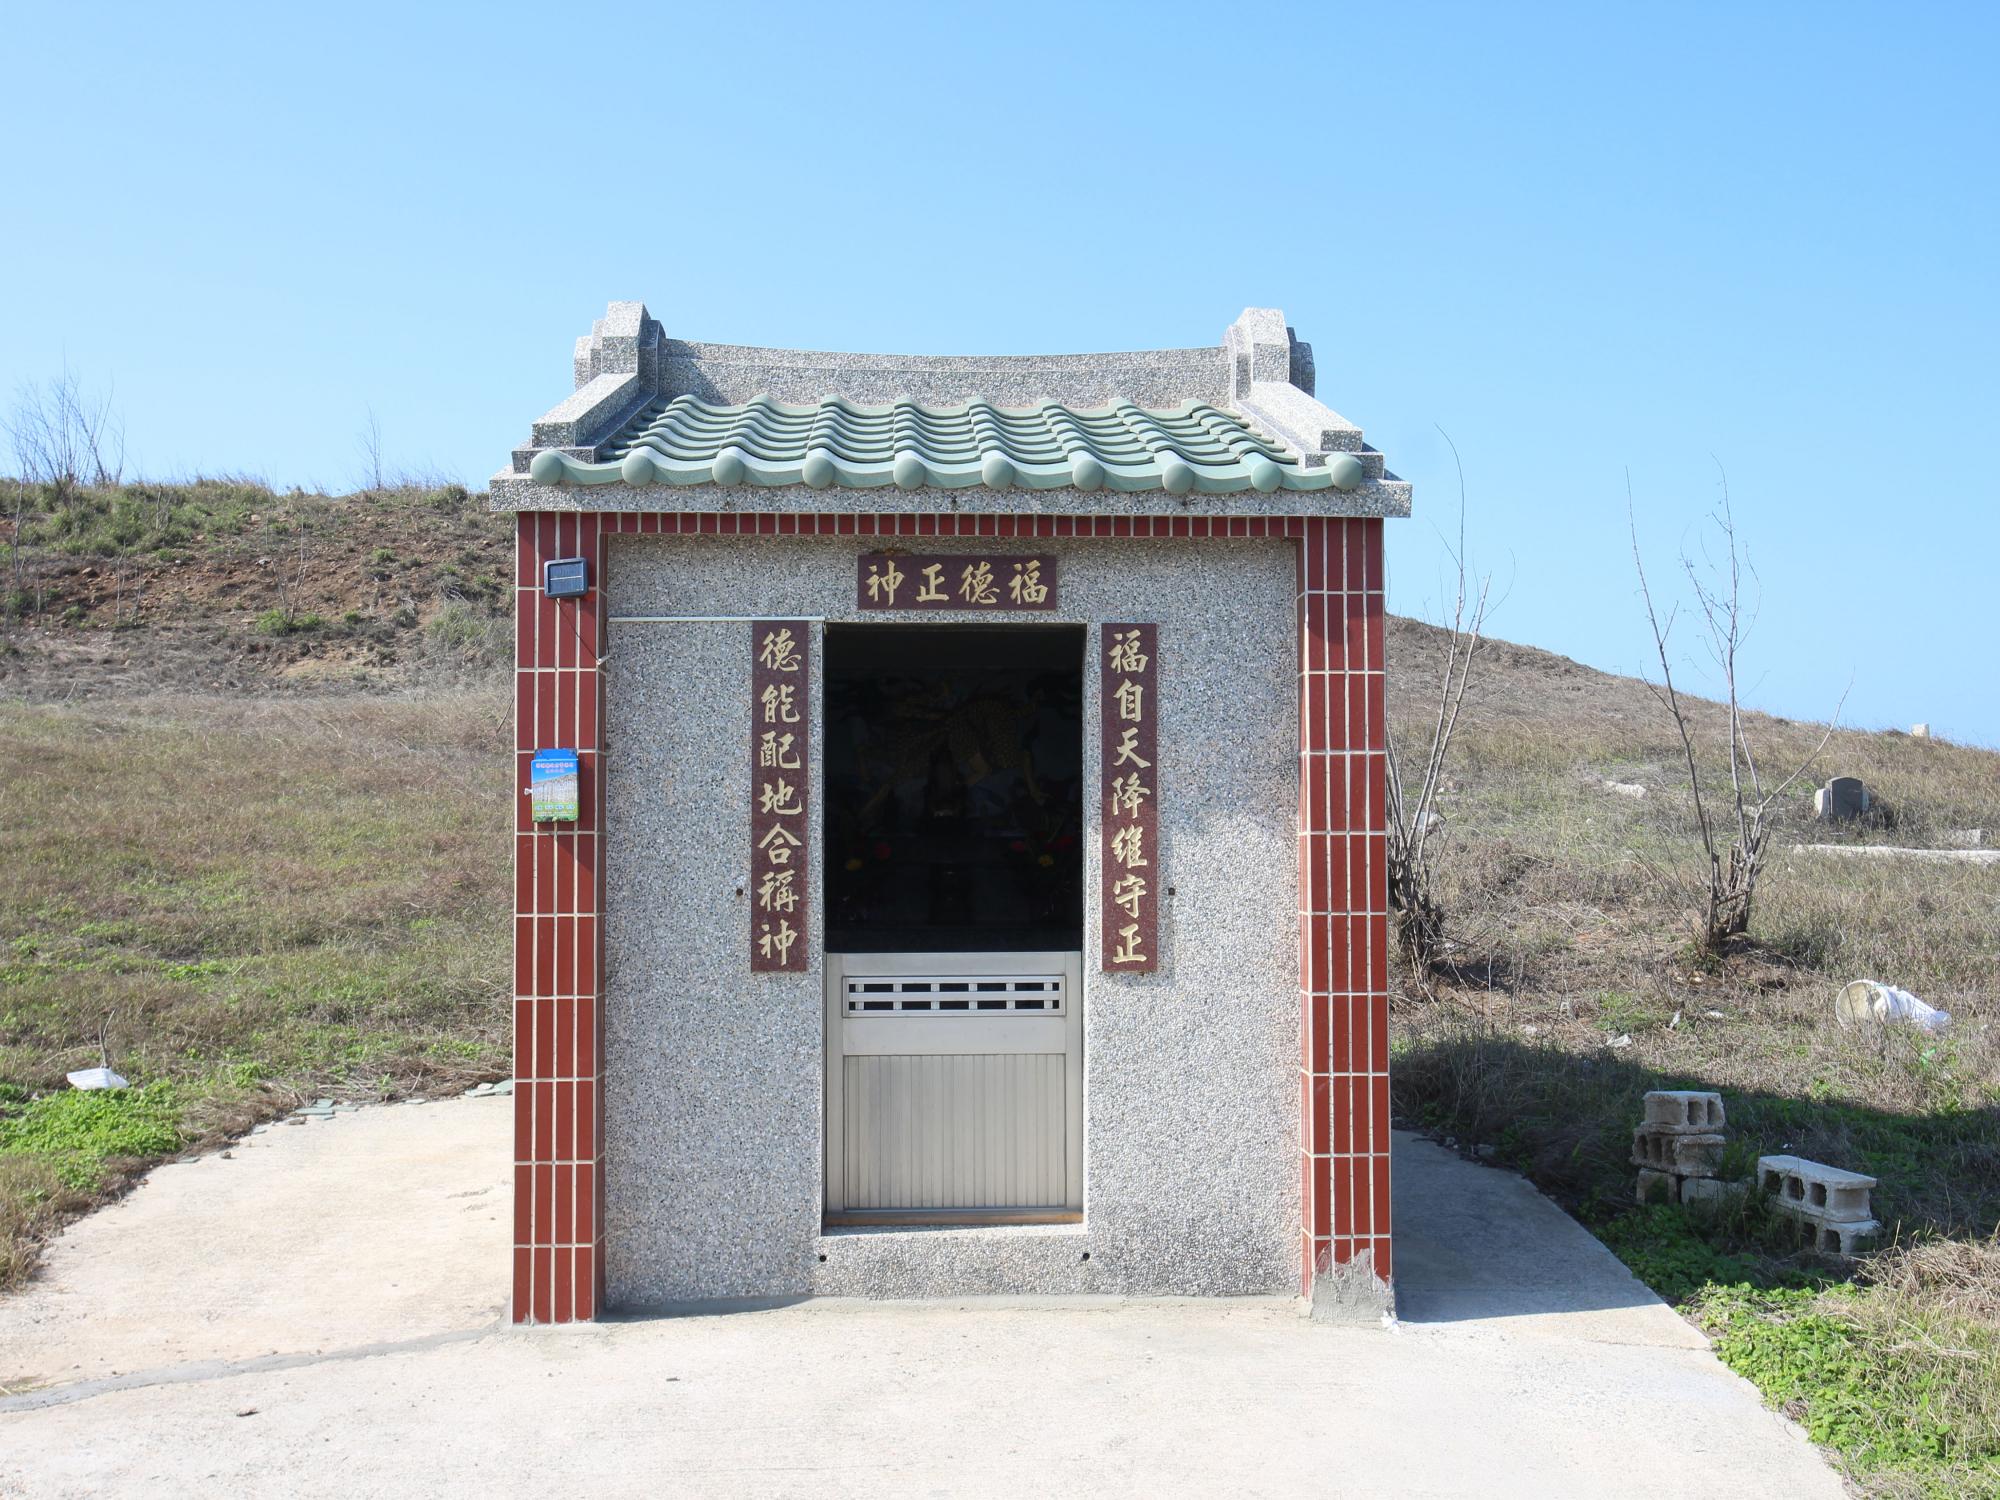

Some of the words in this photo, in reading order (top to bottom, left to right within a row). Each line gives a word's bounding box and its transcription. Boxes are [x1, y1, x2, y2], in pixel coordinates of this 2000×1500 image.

[757, 628, 803, 966] 德能配地合稱神
[1108, 628, 1152, 965] 福自天降維守正
